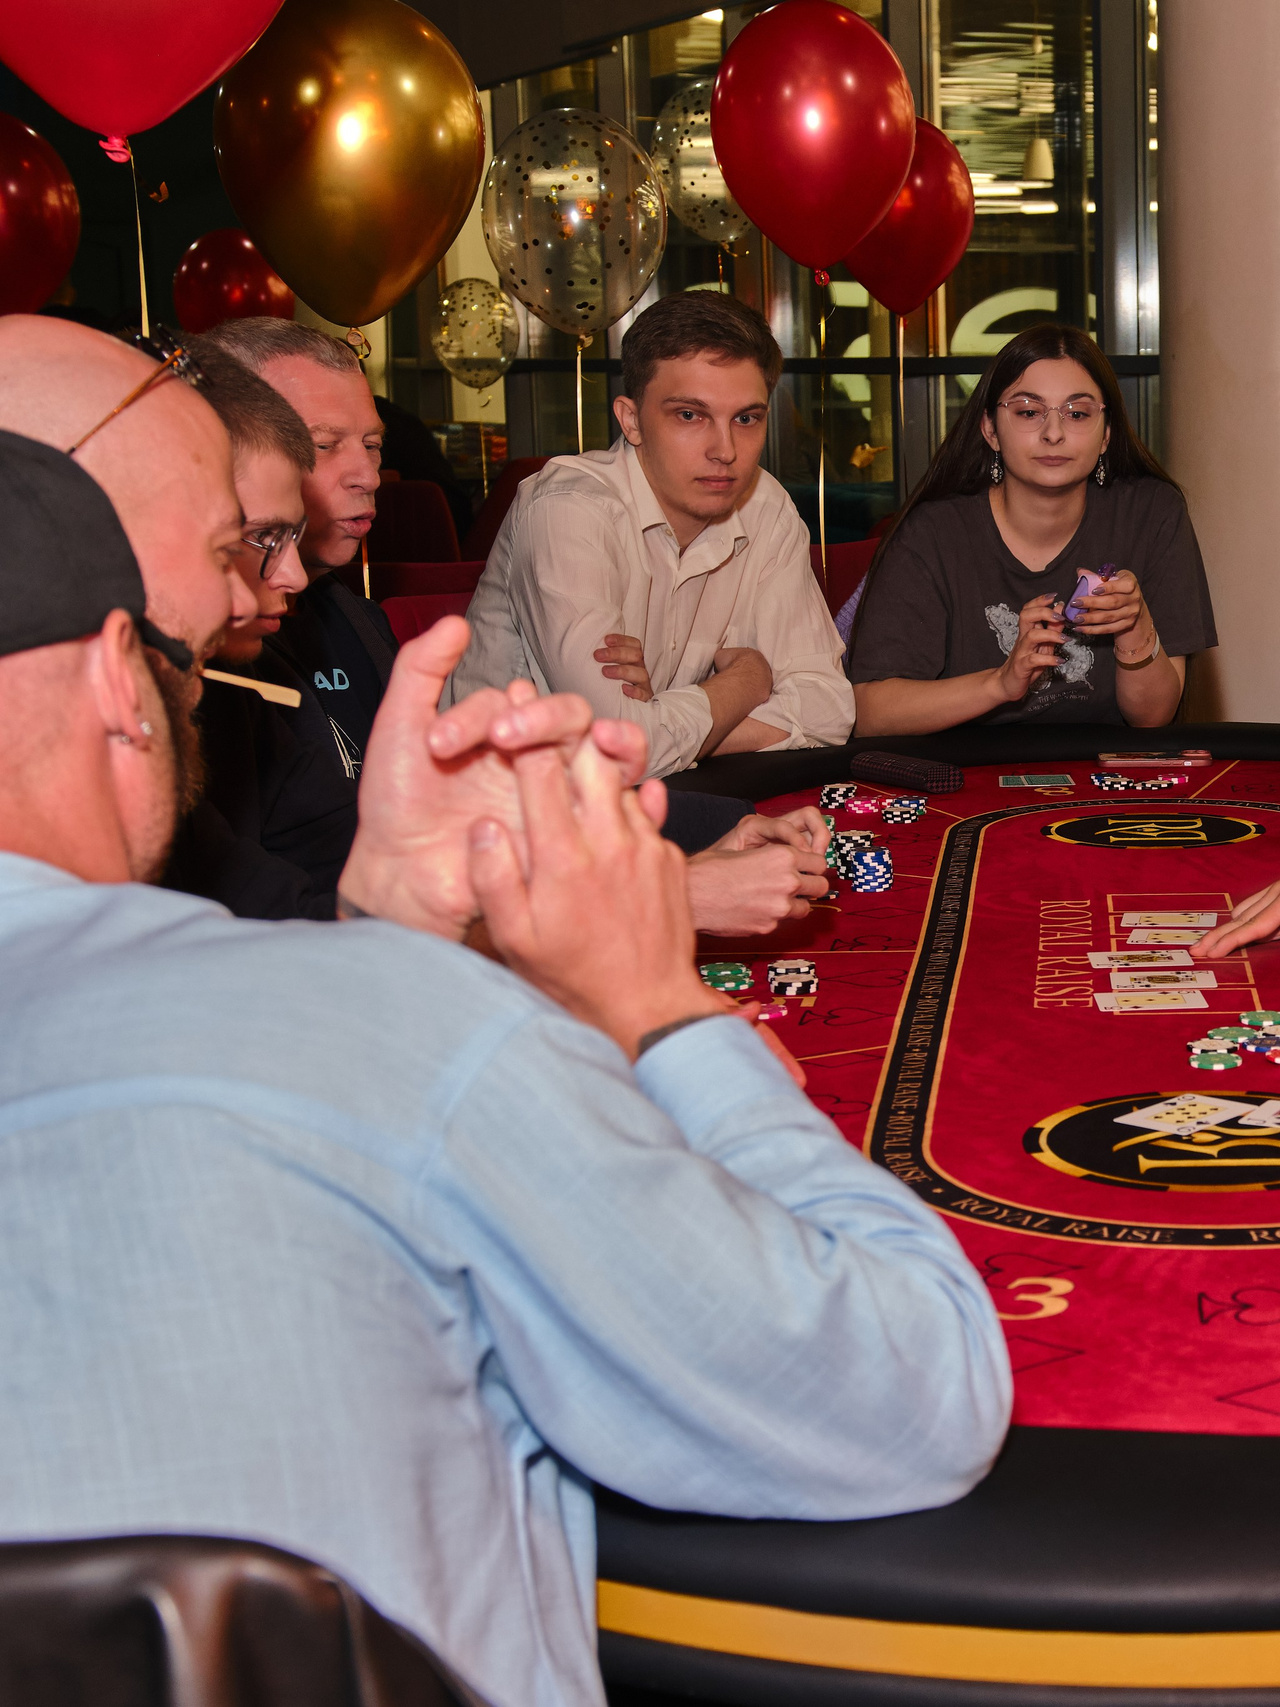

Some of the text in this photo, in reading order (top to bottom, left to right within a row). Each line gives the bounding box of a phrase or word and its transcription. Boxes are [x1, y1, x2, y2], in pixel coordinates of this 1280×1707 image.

[932, 912, 959, 950] ROYAL RAISE
[1033, 899, 1094, 1010] ROYAL RAISE
[920, 952, 951, 996] ROYAL RAISE
[906, 998, 940, 1048] ROYAL RAISE
[891, 1052, 928, 1110] ROYAL RAISE
[883, 1115, 933, 1185] ROYAL RAISE
[952, 1197, 1053, 1231] ROYAL
[1061, 1220, 1176, 1244] RAISE
[997, 1276, 1075, 1321] 3
